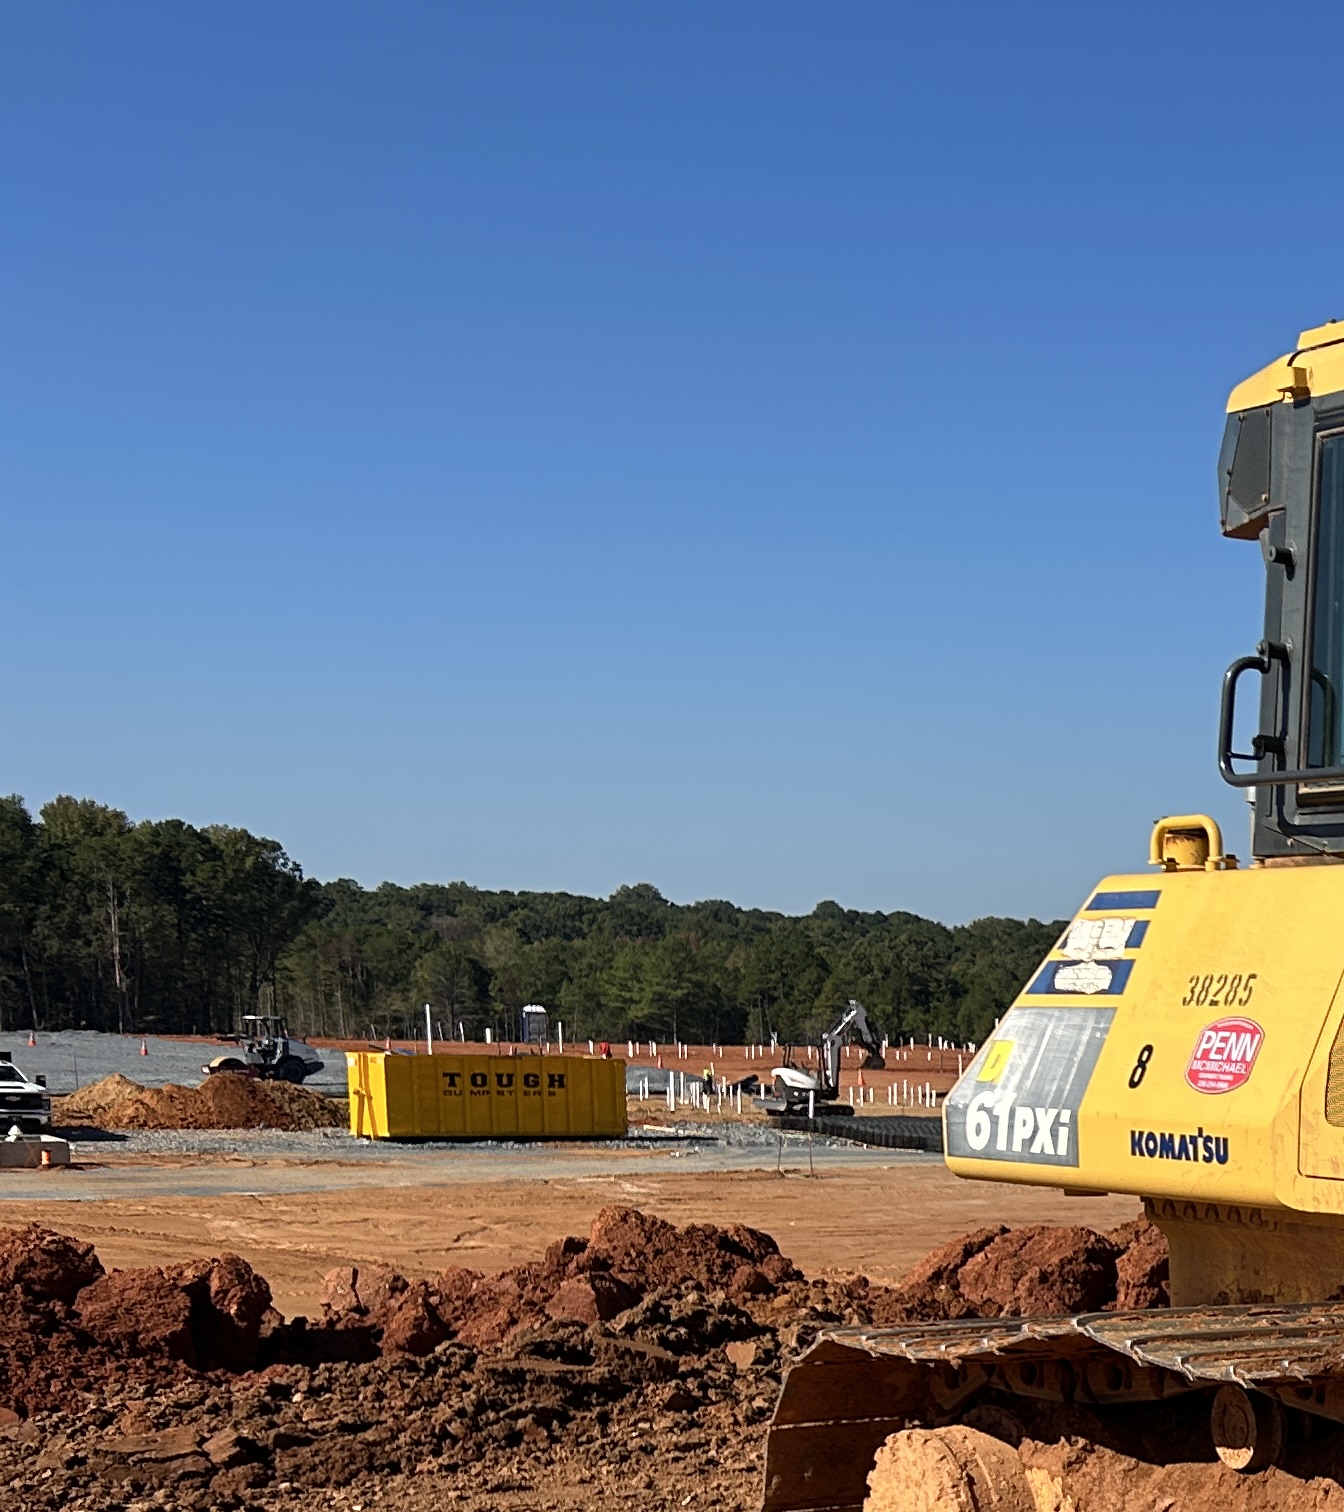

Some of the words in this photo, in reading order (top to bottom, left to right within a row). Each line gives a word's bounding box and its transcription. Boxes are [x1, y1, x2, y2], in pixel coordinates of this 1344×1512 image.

[1182, 974, 1258, 1006] 38285
[1196, 1030, 1261, 1062] PENN
[442, 1072, 566, 1089] TOUGH
[1128, 1044, 1154, 1089] 8
[965, 1090, 1072, 1156] 61PXi
[1130, 1126, 1229, 1165] KOMATSU
